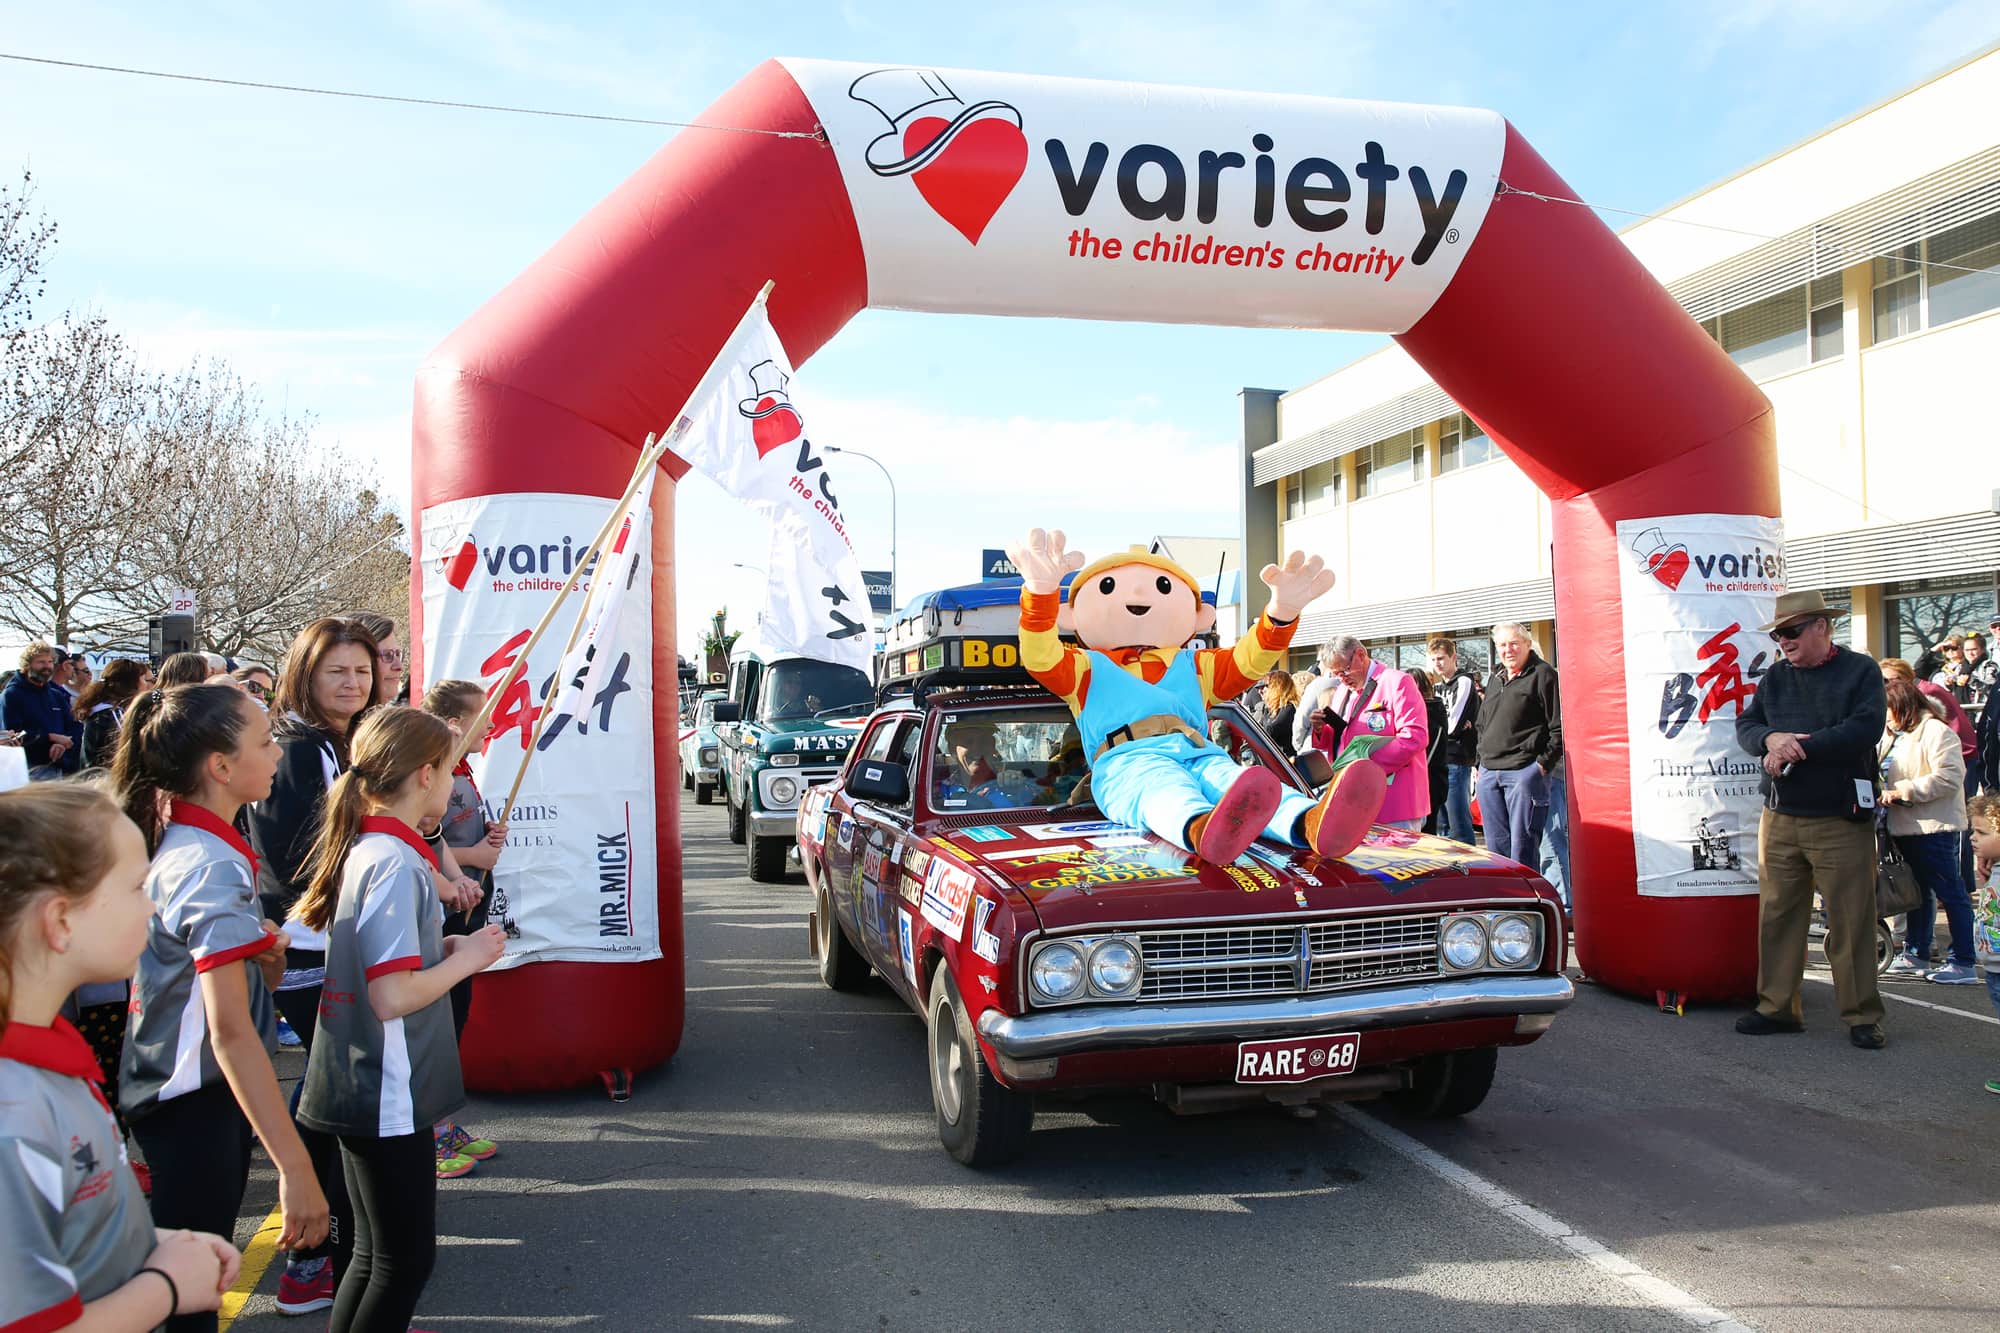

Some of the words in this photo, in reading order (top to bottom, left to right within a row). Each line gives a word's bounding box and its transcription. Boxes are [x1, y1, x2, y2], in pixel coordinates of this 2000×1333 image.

[1044, 133, 1468, 266] variety
[1067, 228, 1123, 261] the
[1132, 231, 1285, 269] children's
[1295, 242, 1404, 281] charity
[788, 475, 813, 500] the
[493, 580, 515, 593] the
[517, 578, 579, 592] childres
[1705, 582, 1724, 592] the
[1726, 581, 1768, 592] children's
[175, 600, 193, 611] 2P
[962, 639, 1025, 668] Bo
[1653, 758, 1695, 777] Tim
[1713, 786, 1762, 798] VALLE
[596, 831, 628, 937] MR.MICK
[1343, 963, 1428, 979] HOLDEN
[1242, 1047, 1307, 1077] RARE
[1327, 1042, 1355, 1068] 68
